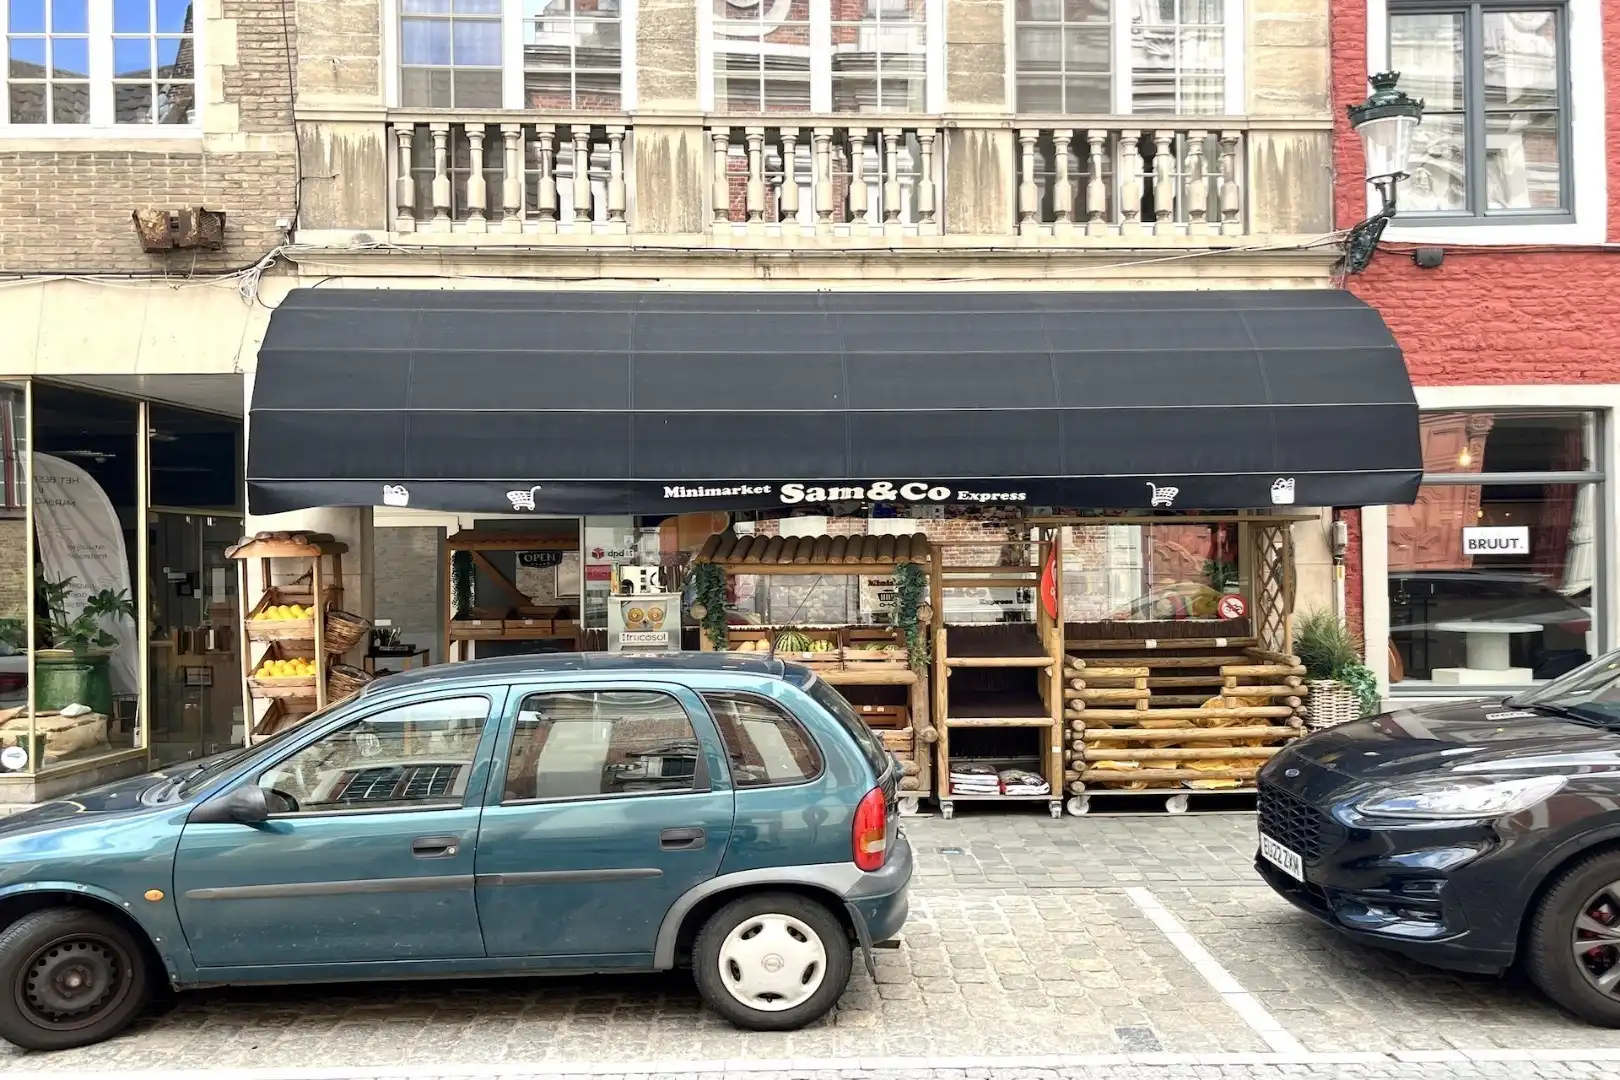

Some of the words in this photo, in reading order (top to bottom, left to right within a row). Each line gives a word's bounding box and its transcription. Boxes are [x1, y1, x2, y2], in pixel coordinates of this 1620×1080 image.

[663, 484, 772, 499] Minimarket
[780, 481, 951, 504] Sam&Co
[957, 490, 1027, 503] Express
[523, 553, 556, 562] OPEN
[607, 549, 625, 559] dpd
[626, 633, 666, 642] frucosol
